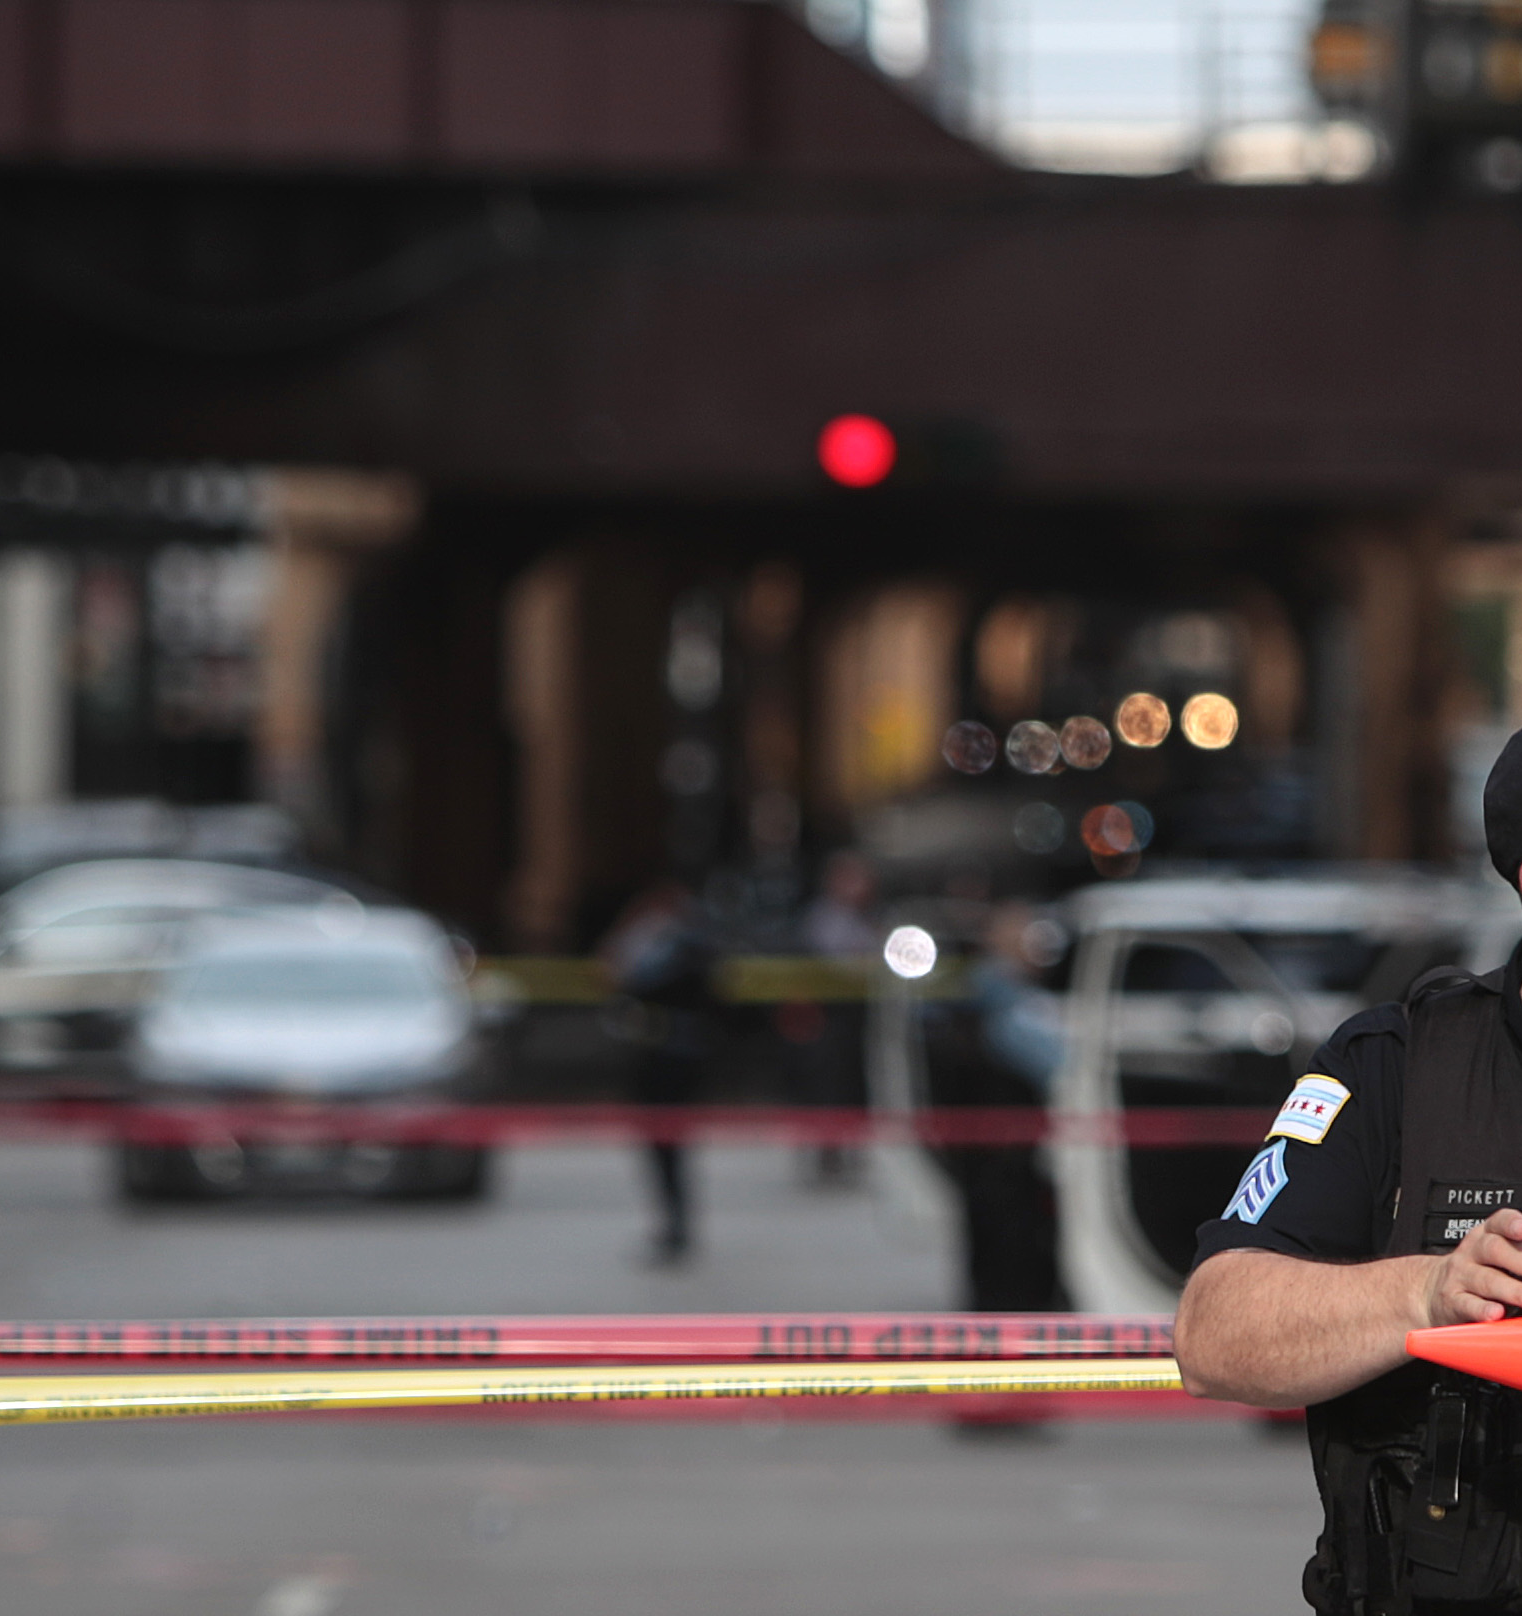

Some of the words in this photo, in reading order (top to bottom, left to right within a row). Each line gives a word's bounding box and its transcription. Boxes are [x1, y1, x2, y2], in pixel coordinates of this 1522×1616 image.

[1448, 1189, 1515, 1205] PICKETT
[752, 1324, 851, 1357] OUT
[873, 1324, 1001, 1358] KEEP
